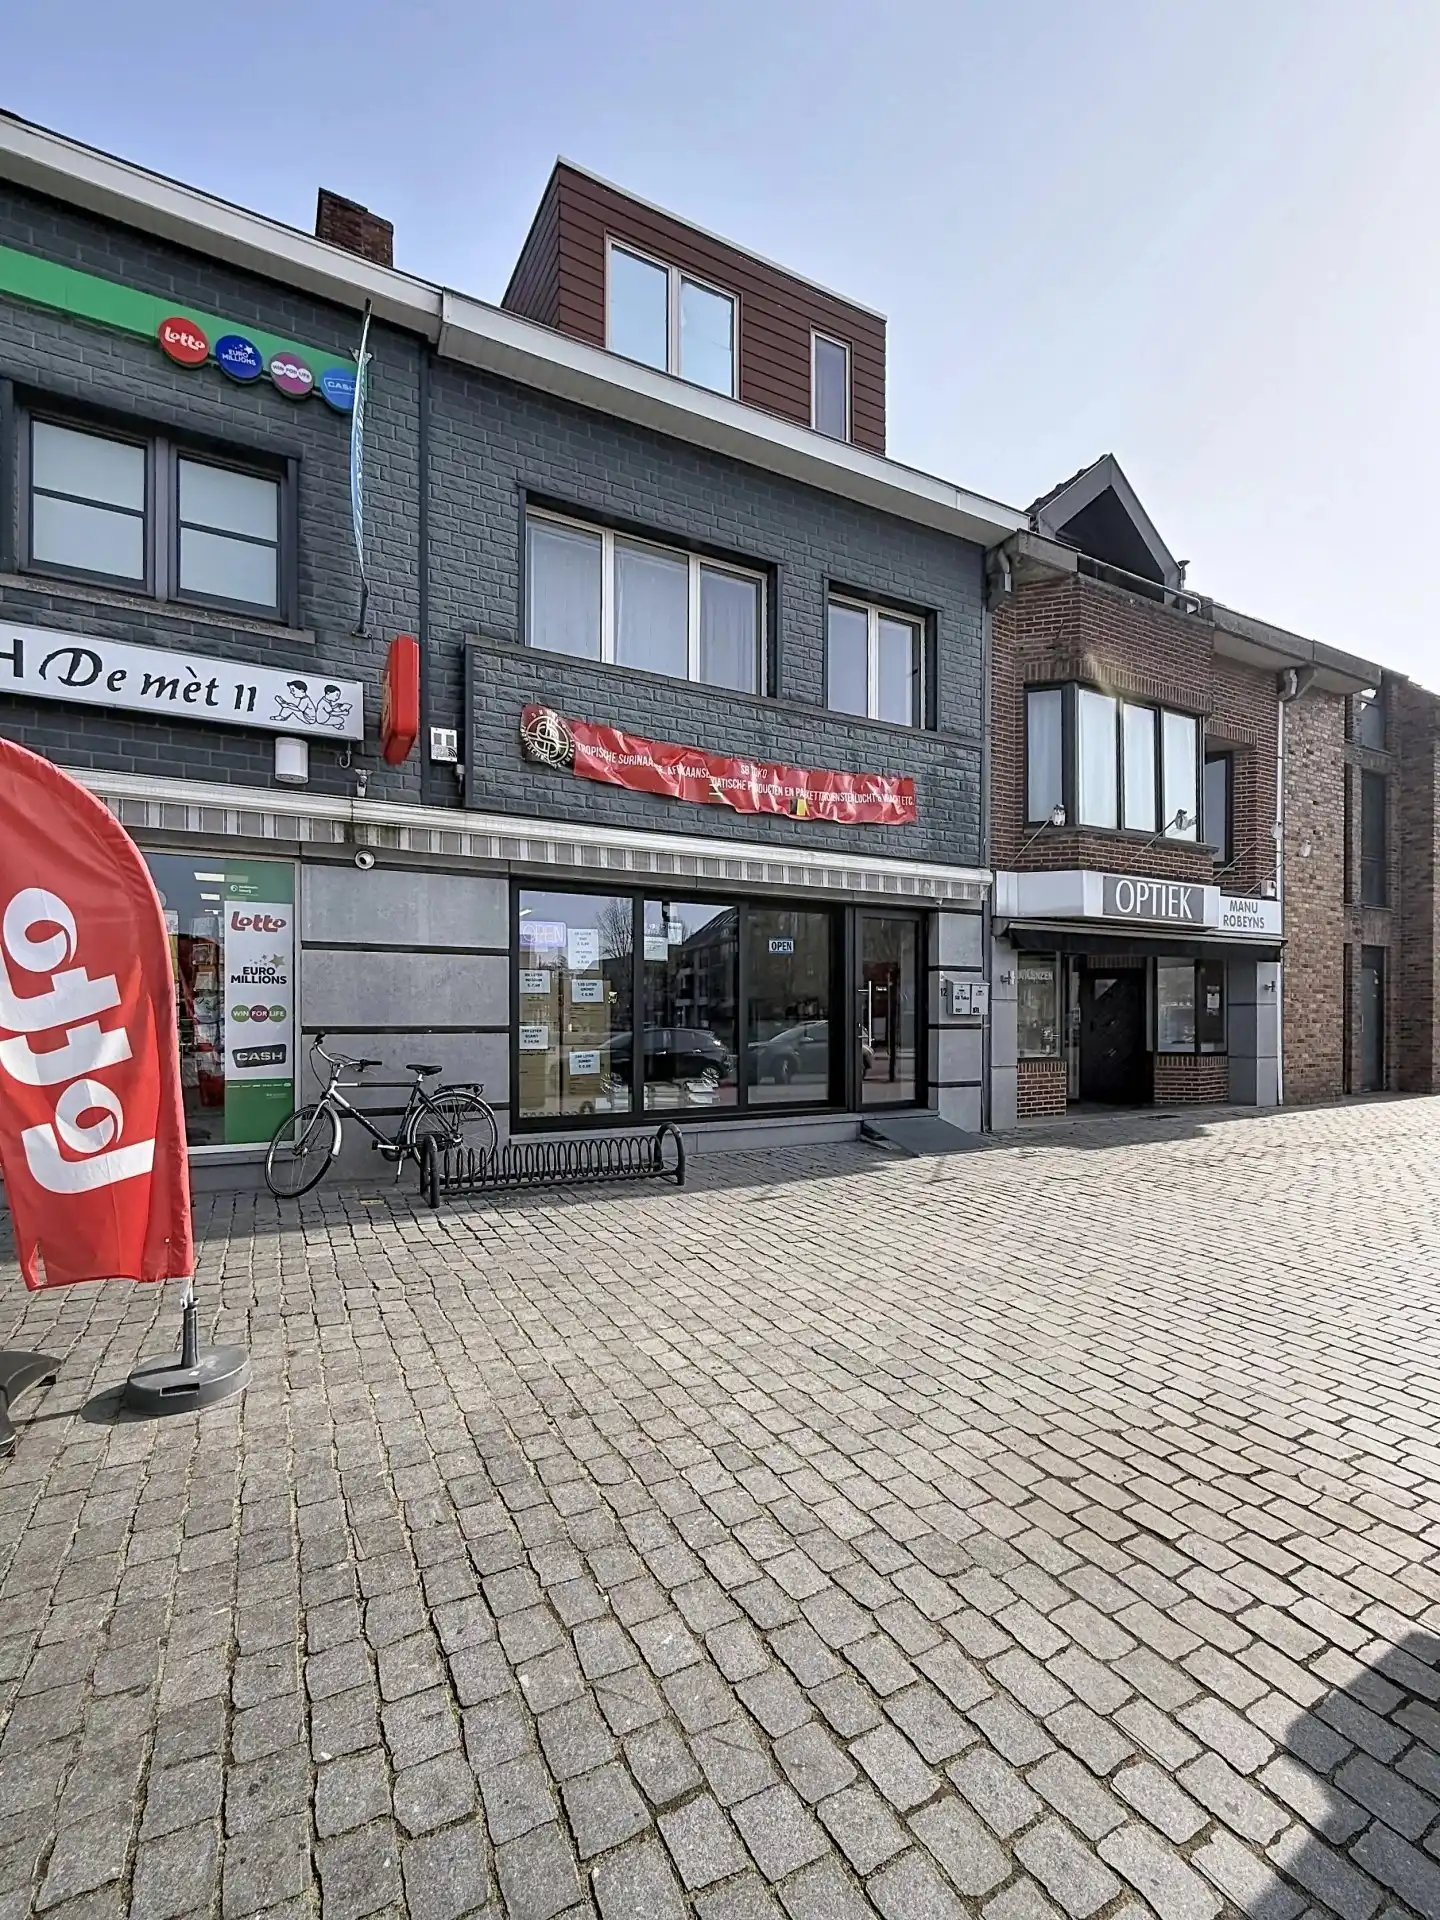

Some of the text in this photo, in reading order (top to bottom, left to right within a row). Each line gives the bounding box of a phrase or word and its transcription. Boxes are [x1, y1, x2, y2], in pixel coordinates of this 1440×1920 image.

[164, 326, 206, 351] Lotto
[221, 352, 257, 366] MILLIONS
[228, 349, 249, 358] EURO
[38, 647, 127, 693] De
[140, 665, 220, 707] mèt
[577, 743, 616, 764] TROPISCHE
[901, 796, 915, 806] ETC.
[1115, 879, 1193, 919] OPTIEK
[1229, 900, 1258, 914] MANU
[231, 911, 287, 933] Lotto
[1223, 914, 1265, 929] ROBEYNS
[522, 924, 564, 942] OPEN
[771, 941, 792, 951] OPEN
[242, 966, 276, 976] EURO
[230, 975, 287, 985] MILLIONS
[940, 987, 948, 997] 12
[236, 1051, 283, 1061] CASH
